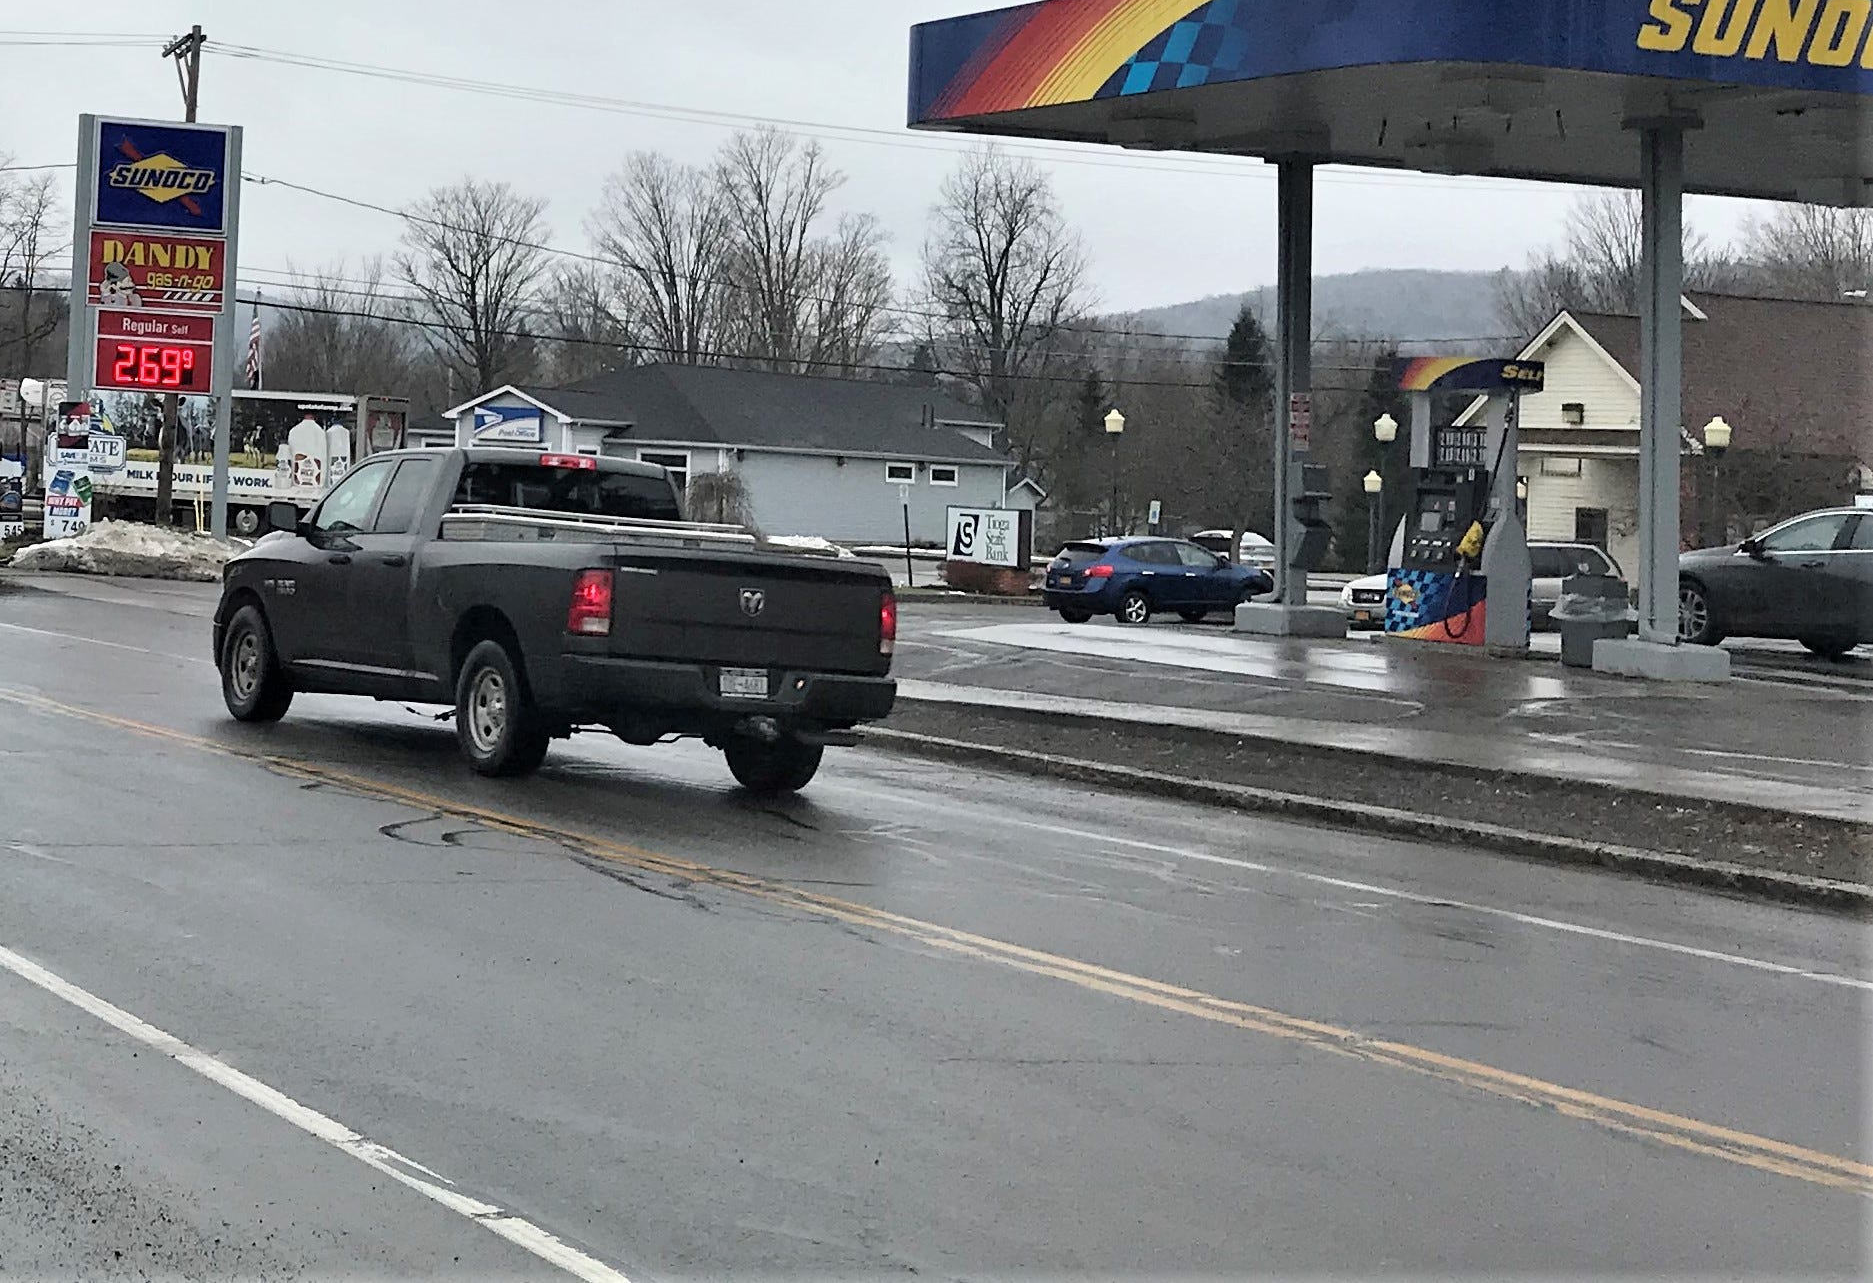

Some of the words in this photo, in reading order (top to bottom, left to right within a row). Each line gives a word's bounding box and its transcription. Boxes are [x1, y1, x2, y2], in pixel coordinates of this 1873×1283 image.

[112, 167, 211, 190] SUNOCO
[102, 239, 215, 270] DANDY
[122, 317, 169, 335] Regular
[171, 325, 189, 335] Self
[88, 439, 119, 456] ATE
[127, 469, 154, 481] MILK
[233, 476, 273, 488] WORK.
[985, 514, 1010, 535] Tioga
[986, 531, 1006, 545] State
[986, 542, 1009, 561] Bank
